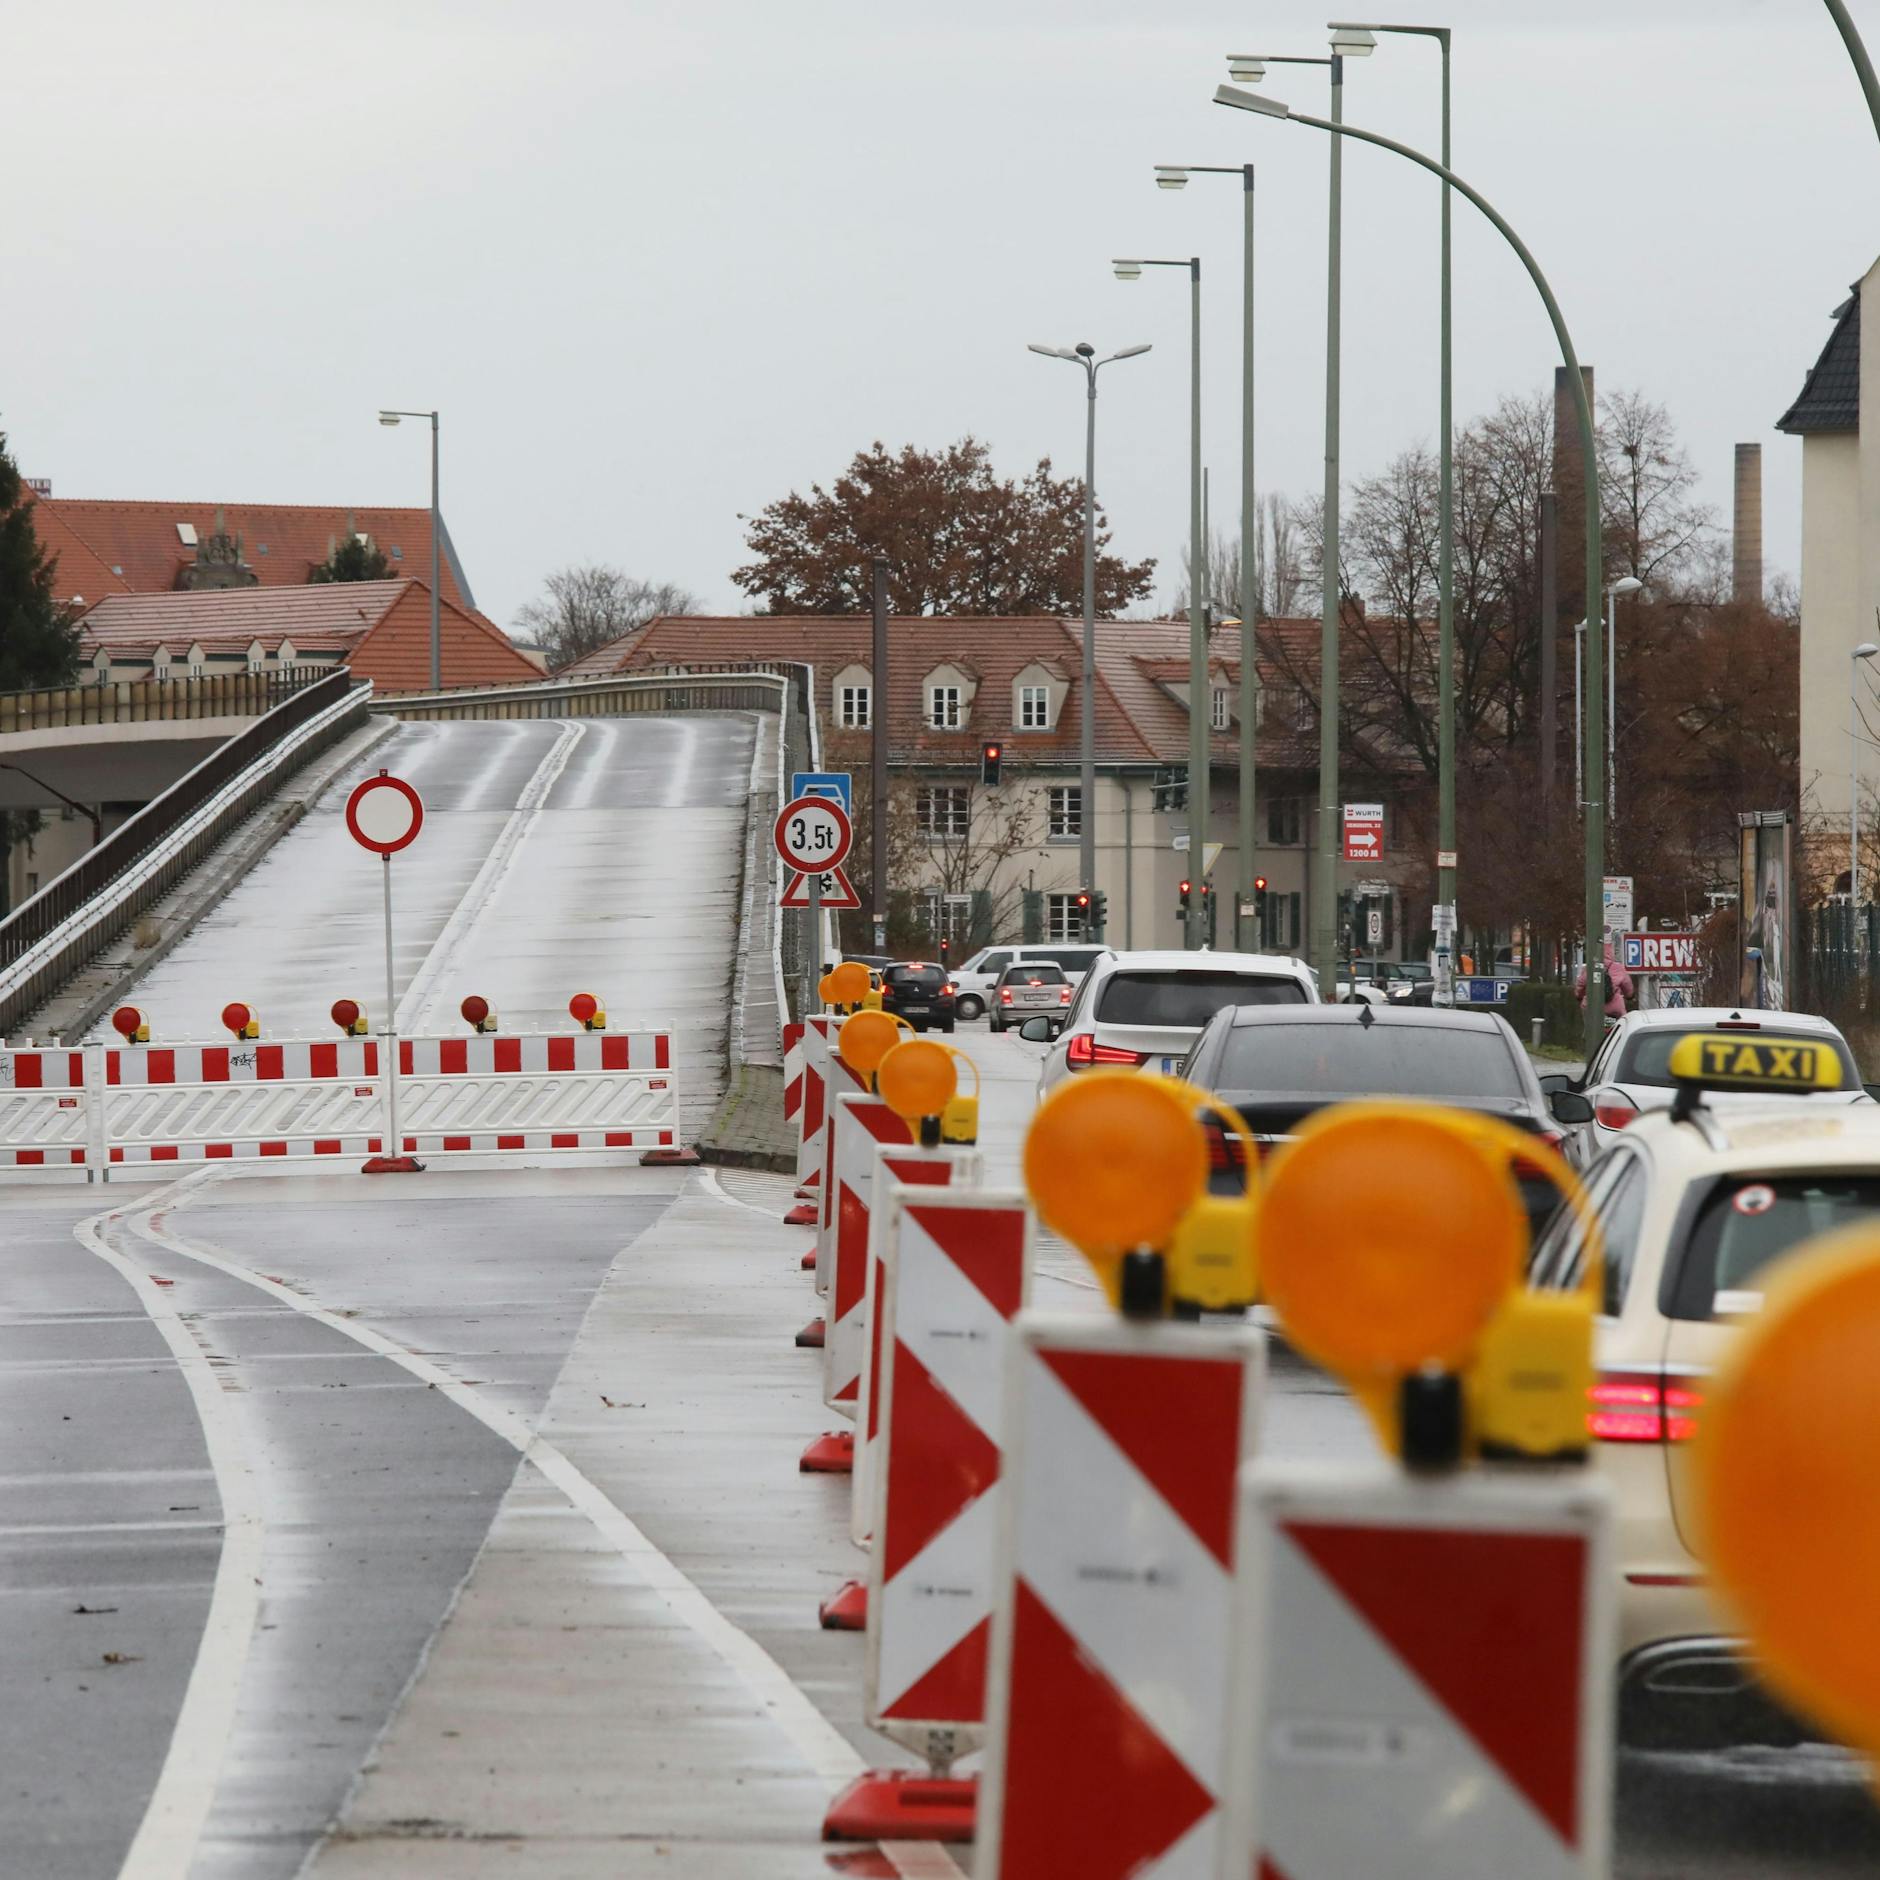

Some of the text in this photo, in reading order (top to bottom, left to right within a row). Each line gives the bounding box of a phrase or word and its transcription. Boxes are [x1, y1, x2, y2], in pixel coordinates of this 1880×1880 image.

[792, 818, 833, 851] 3,5t
[1350, 849, 1369, 858] 1200
[1643, 938, 1702, 968] REW
[1706, 1043, 1813, 1079] TAXI
